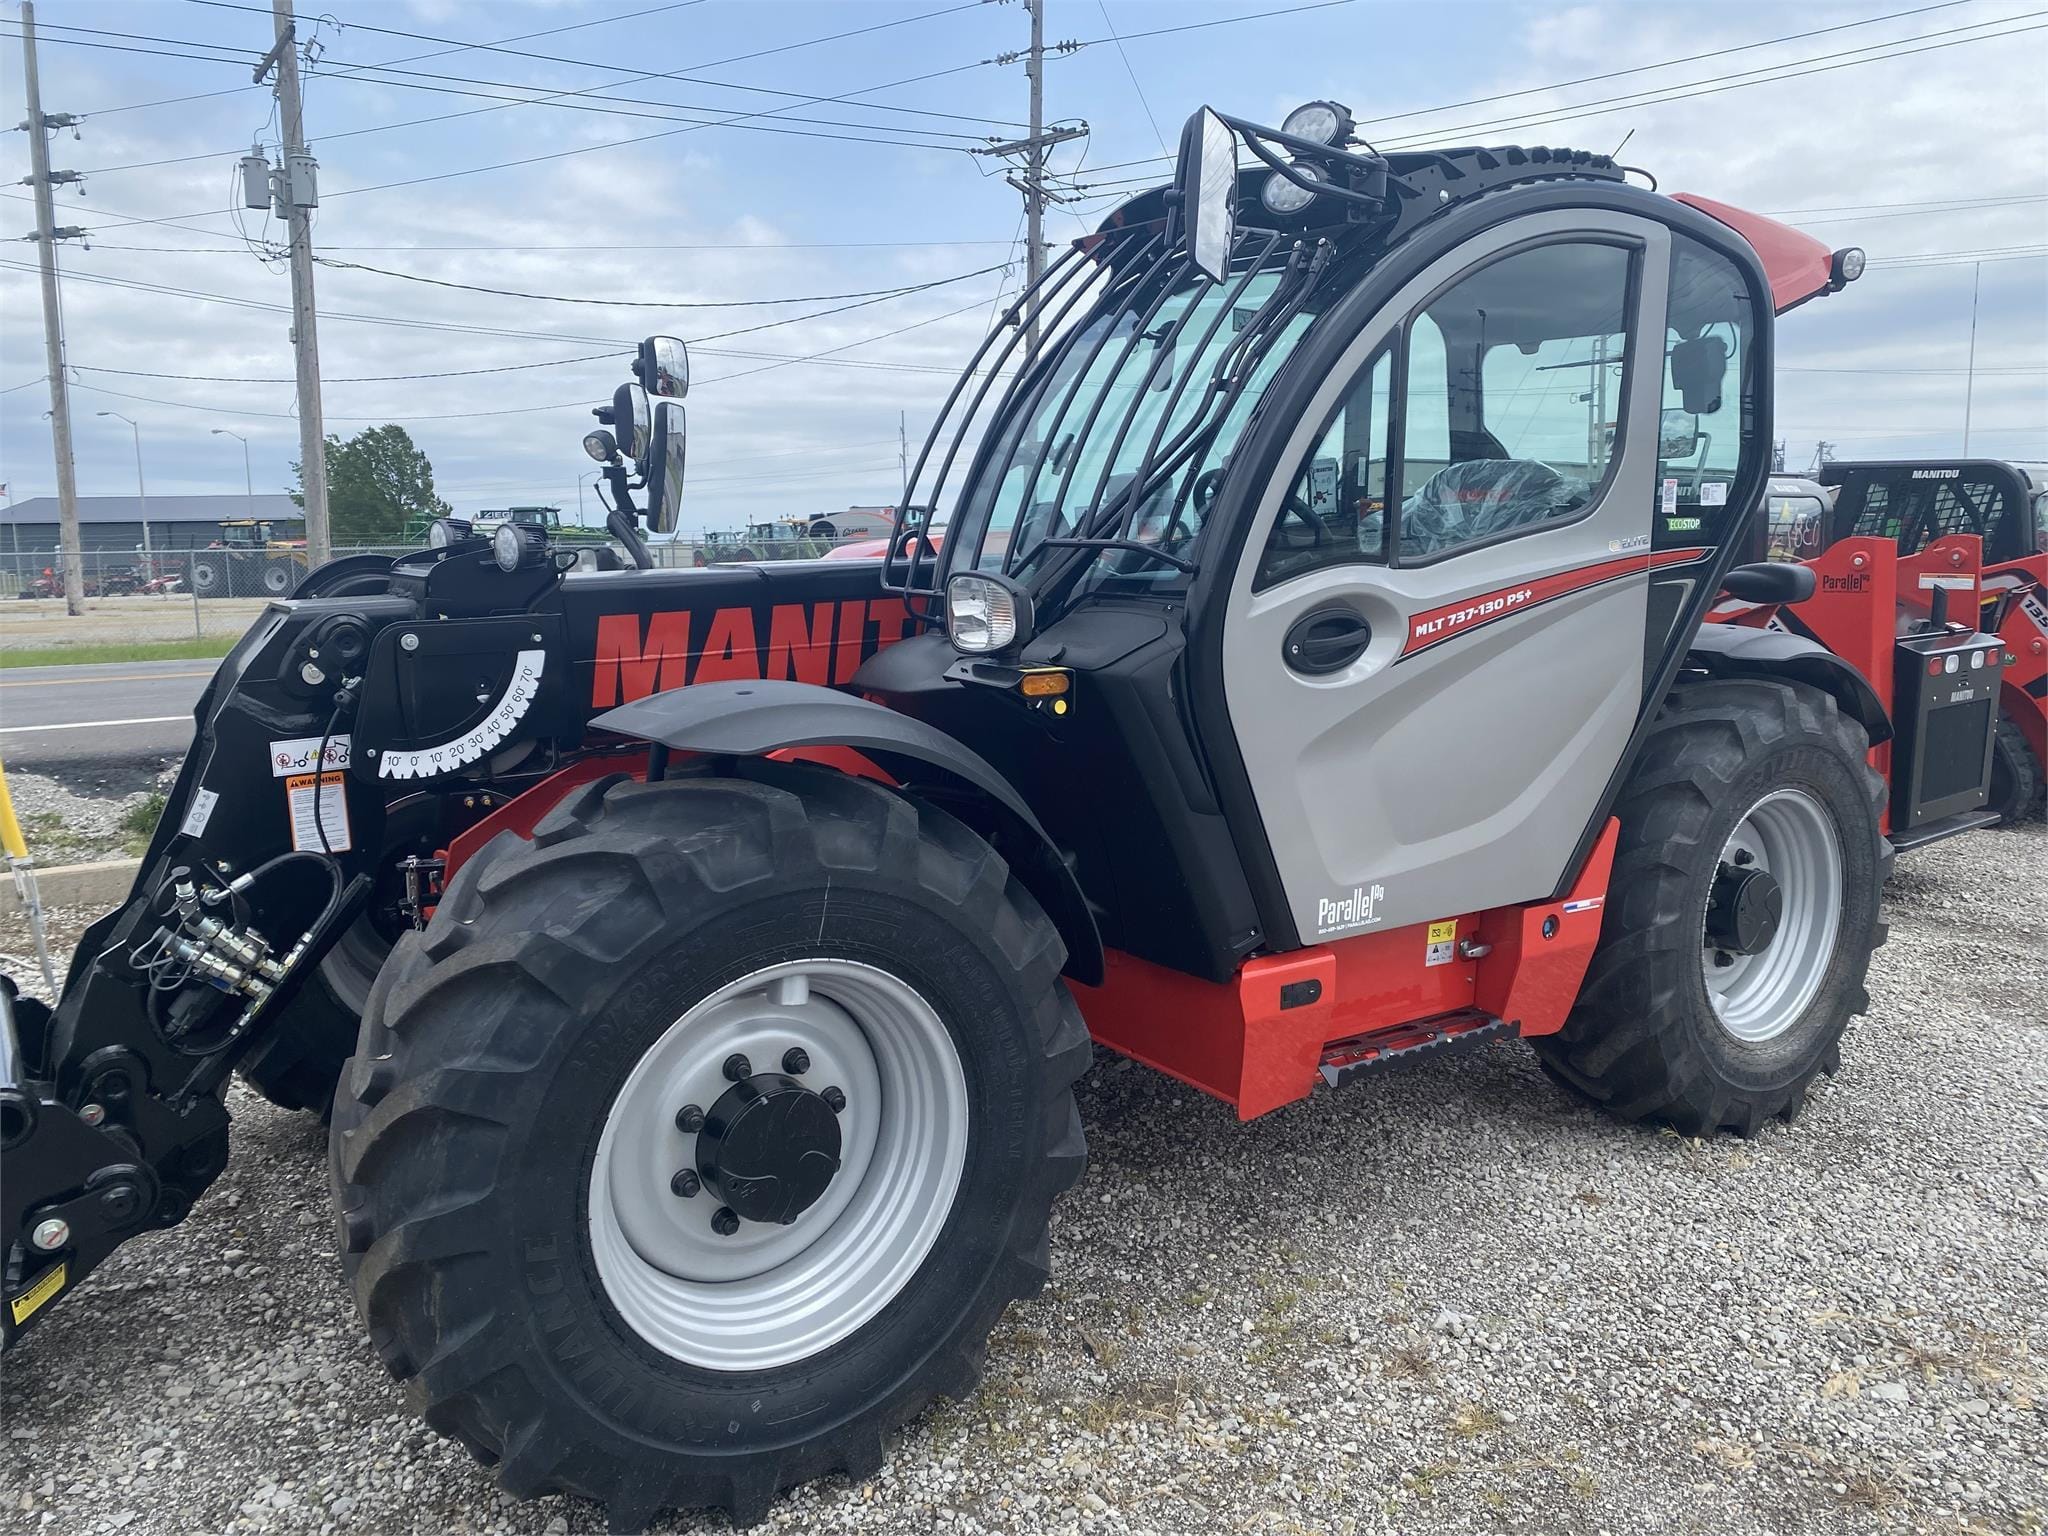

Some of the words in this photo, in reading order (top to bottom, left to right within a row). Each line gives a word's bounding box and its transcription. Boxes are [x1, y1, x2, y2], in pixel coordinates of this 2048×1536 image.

[1912, 469, 1960, 479] MANITOU
[1671, 519, 1700, 529] ECOSTOP
[1823, 574, 1862, 591] Parallel
[1415, 618, 1446, 637] MLT
[1448, 598, 1504, 626] 737-130
[1507, 589, 1532, 606] PS+
[592, 597, 928, 709] MANIT
[1318, 885, 1375, 926] Parallel
[525, 1230, 668, 1434] ALLIANCE
